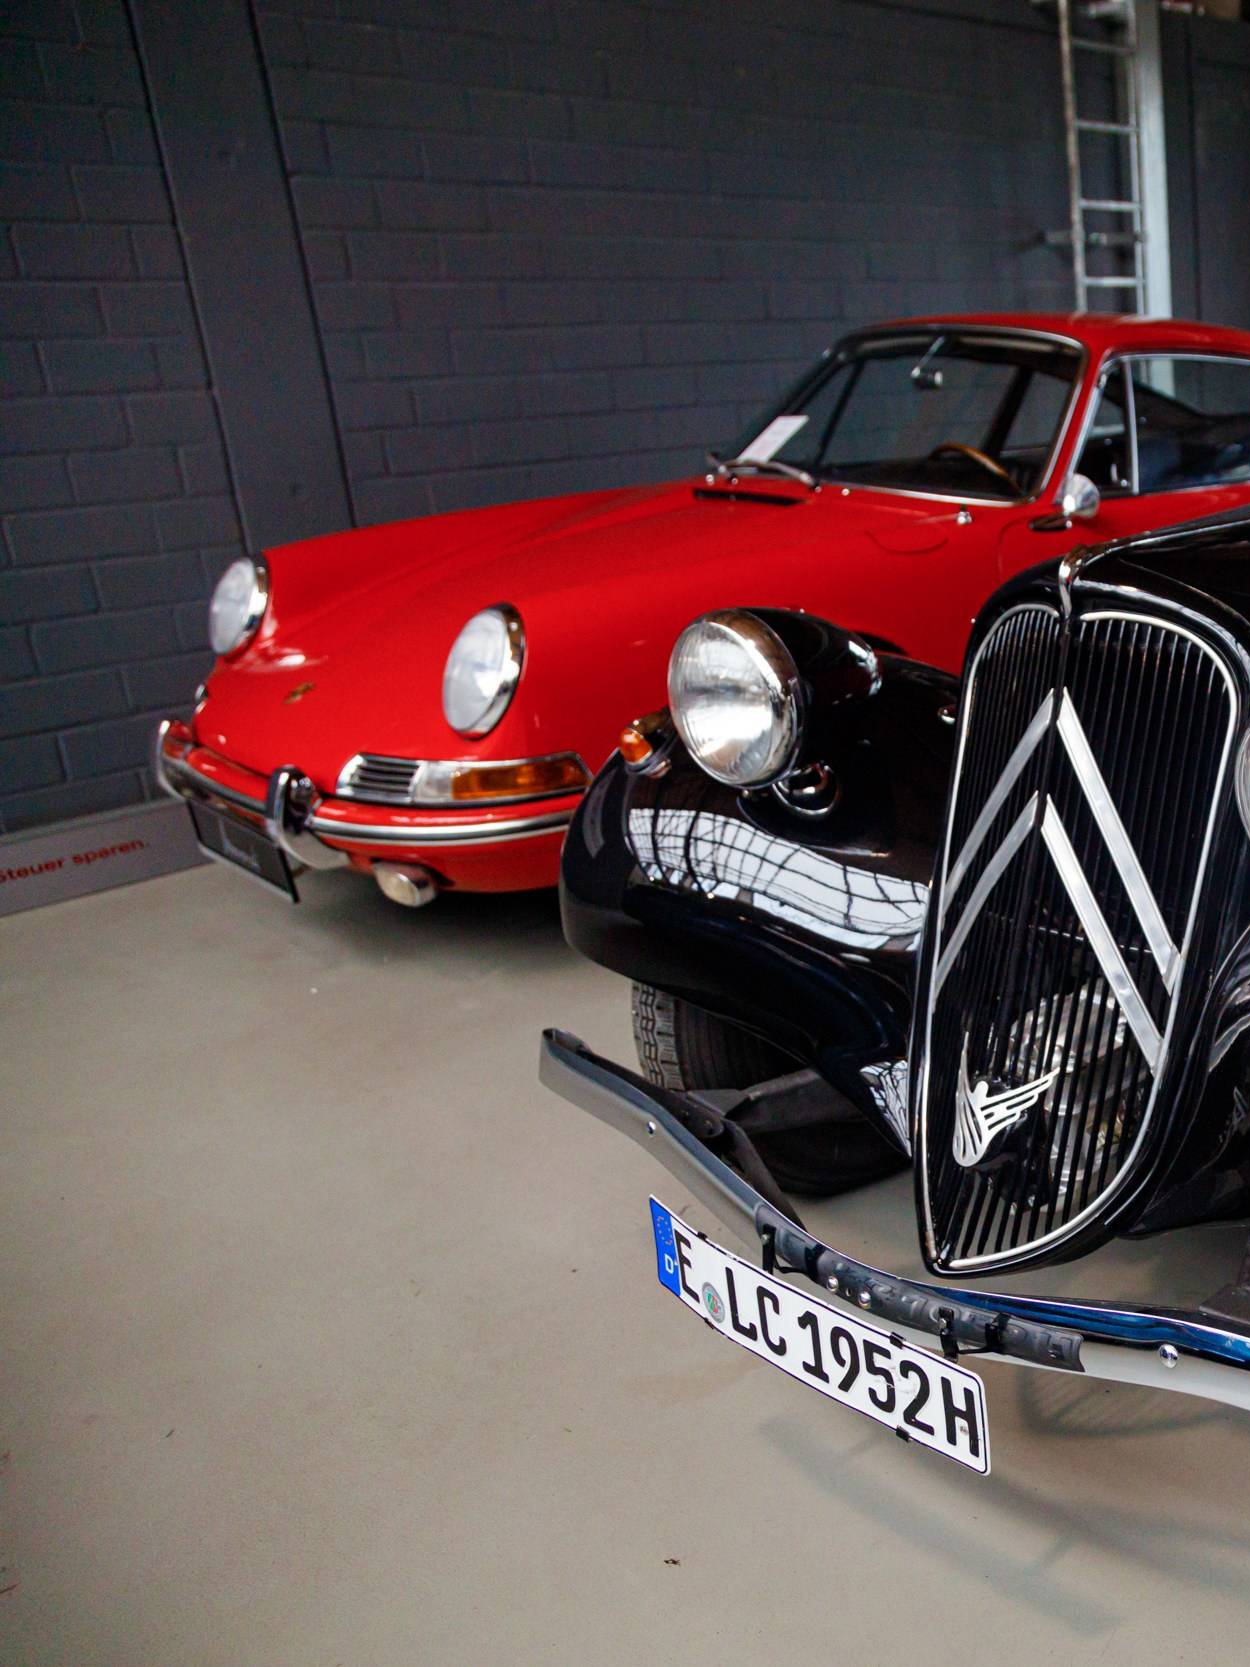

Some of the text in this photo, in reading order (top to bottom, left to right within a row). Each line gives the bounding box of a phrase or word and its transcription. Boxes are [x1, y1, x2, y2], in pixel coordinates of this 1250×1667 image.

[664, 1252, 674, 1274] D
[673, 1227, 981, 1459] E LC 1952H
